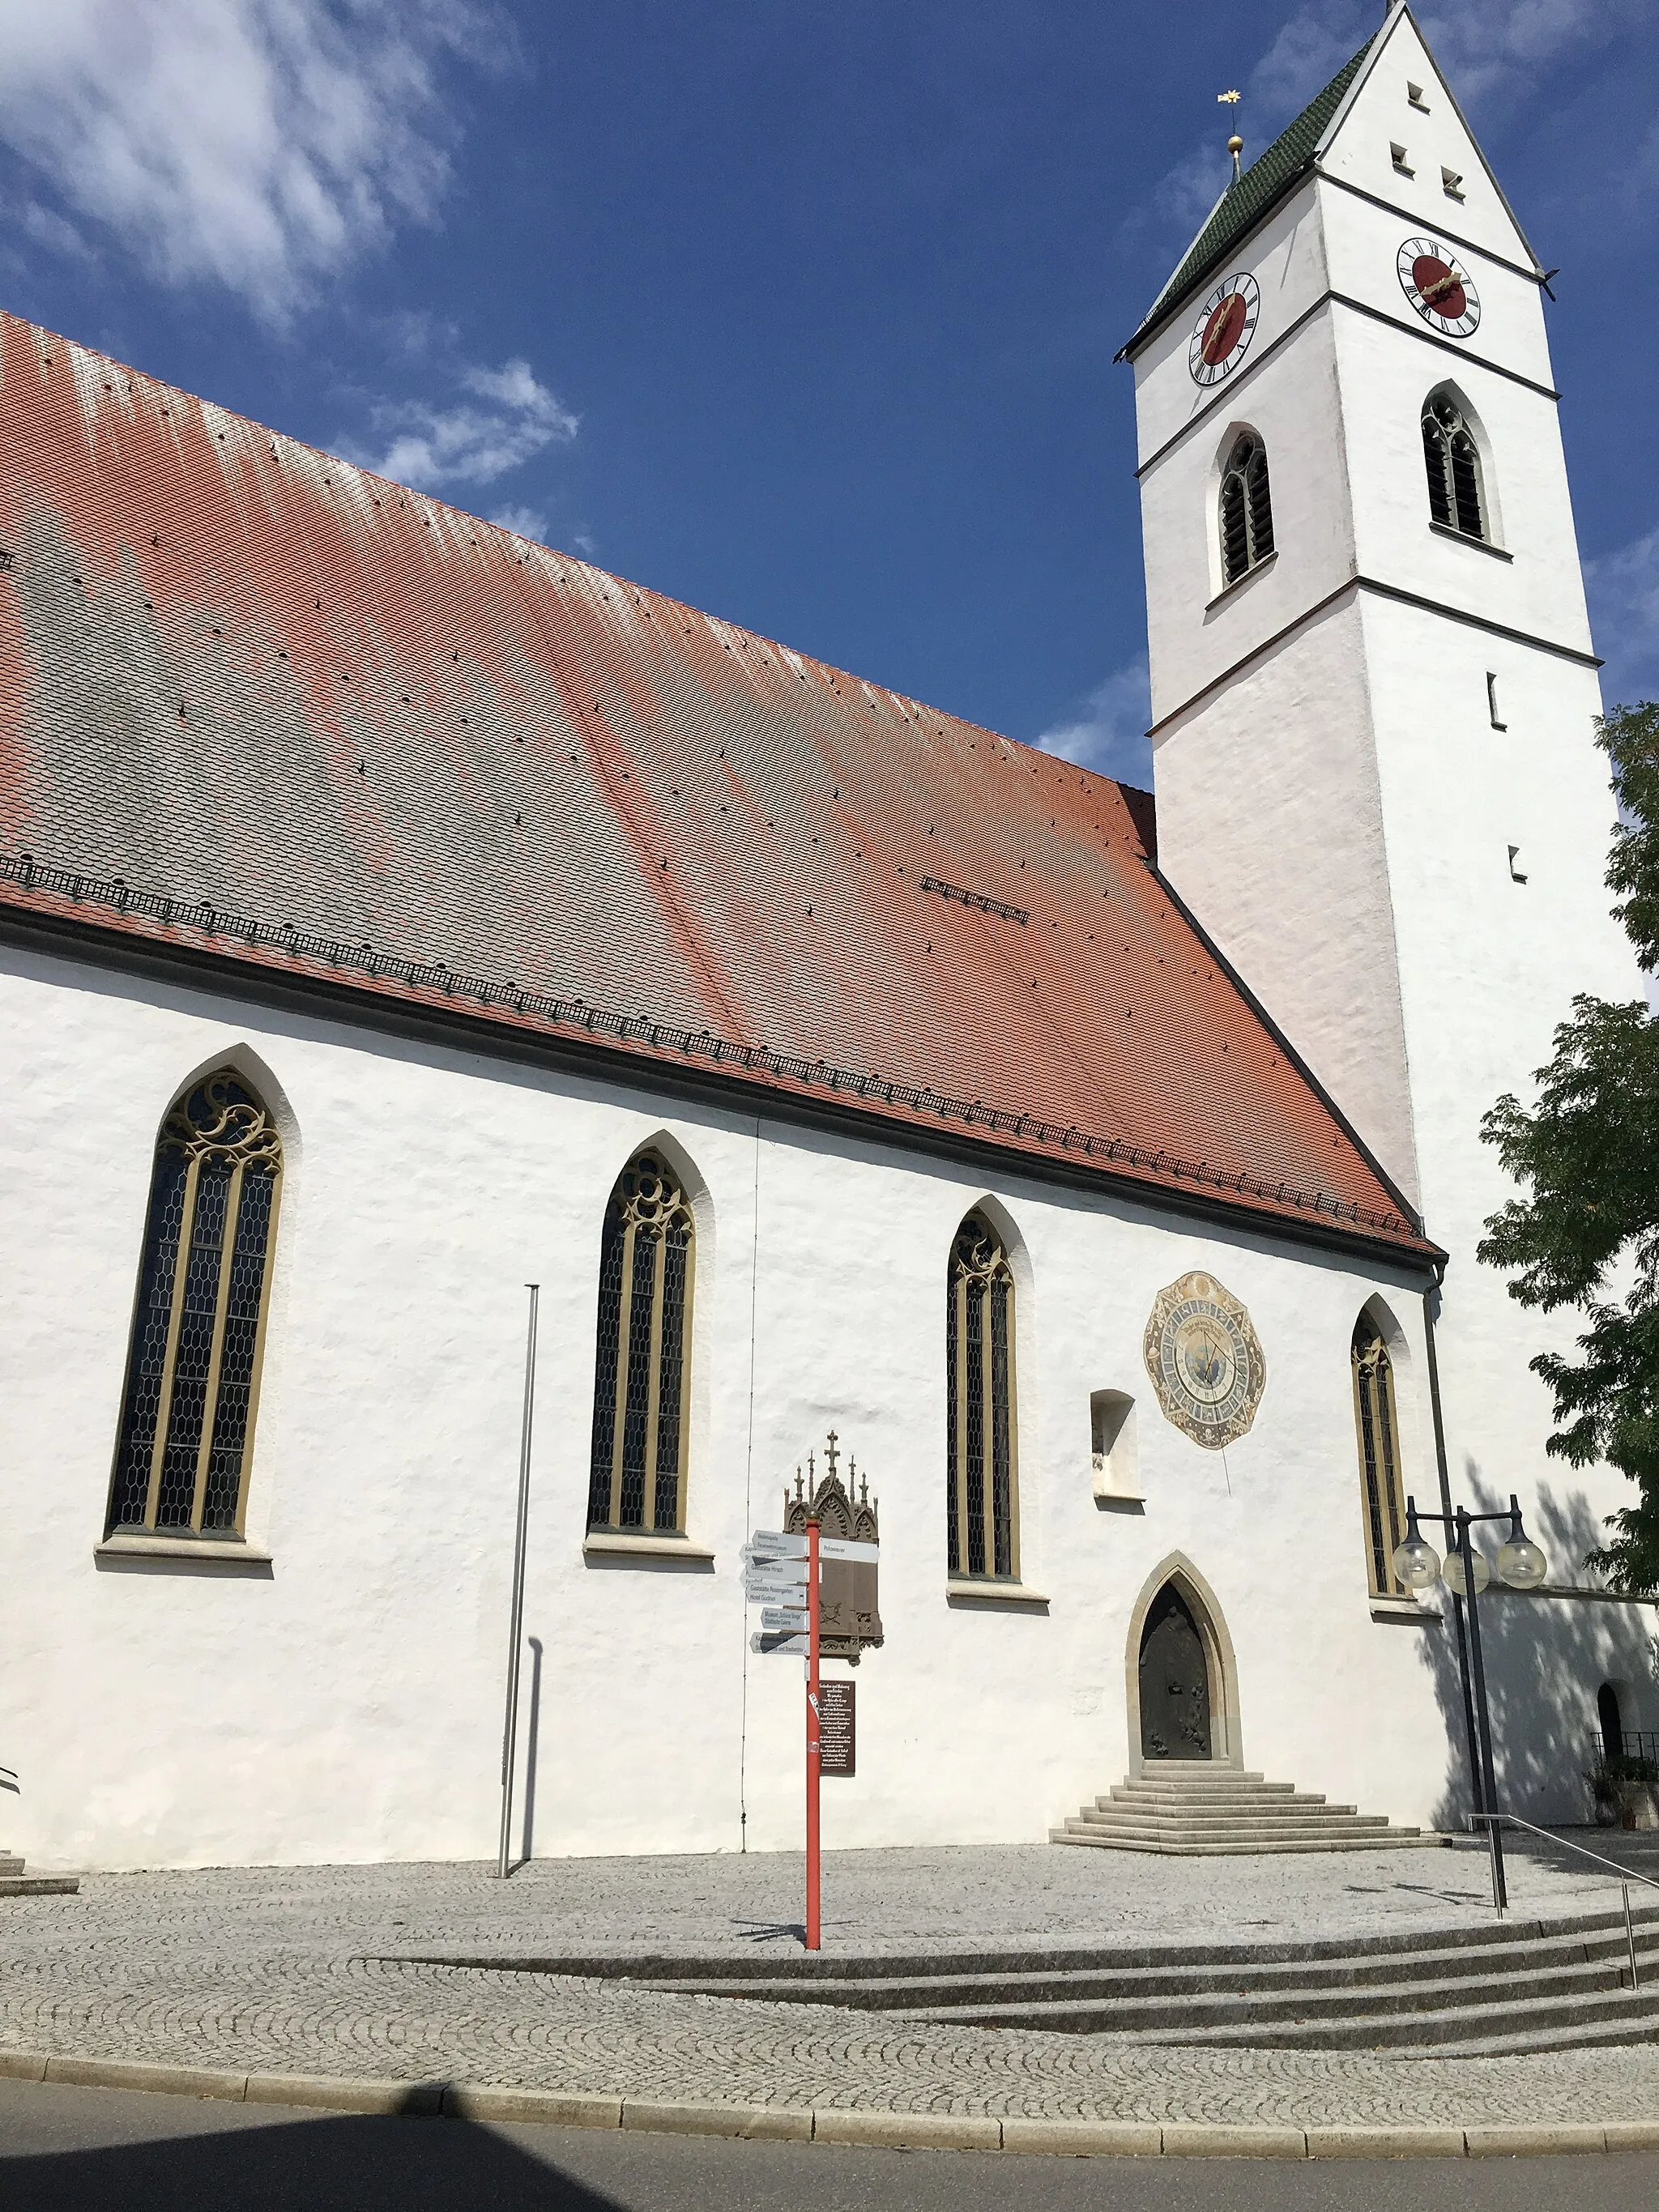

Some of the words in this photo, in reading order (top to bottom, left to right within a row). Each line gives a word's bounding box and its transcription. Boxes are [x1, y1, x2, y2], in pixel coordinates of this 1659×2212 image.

[1401, 247, 1415, 262] X
[1412, 240, 1424, 255] XI
[1428, 242, 1439, 258] XII
[771, 1565, 783, 1573] Hirsch
